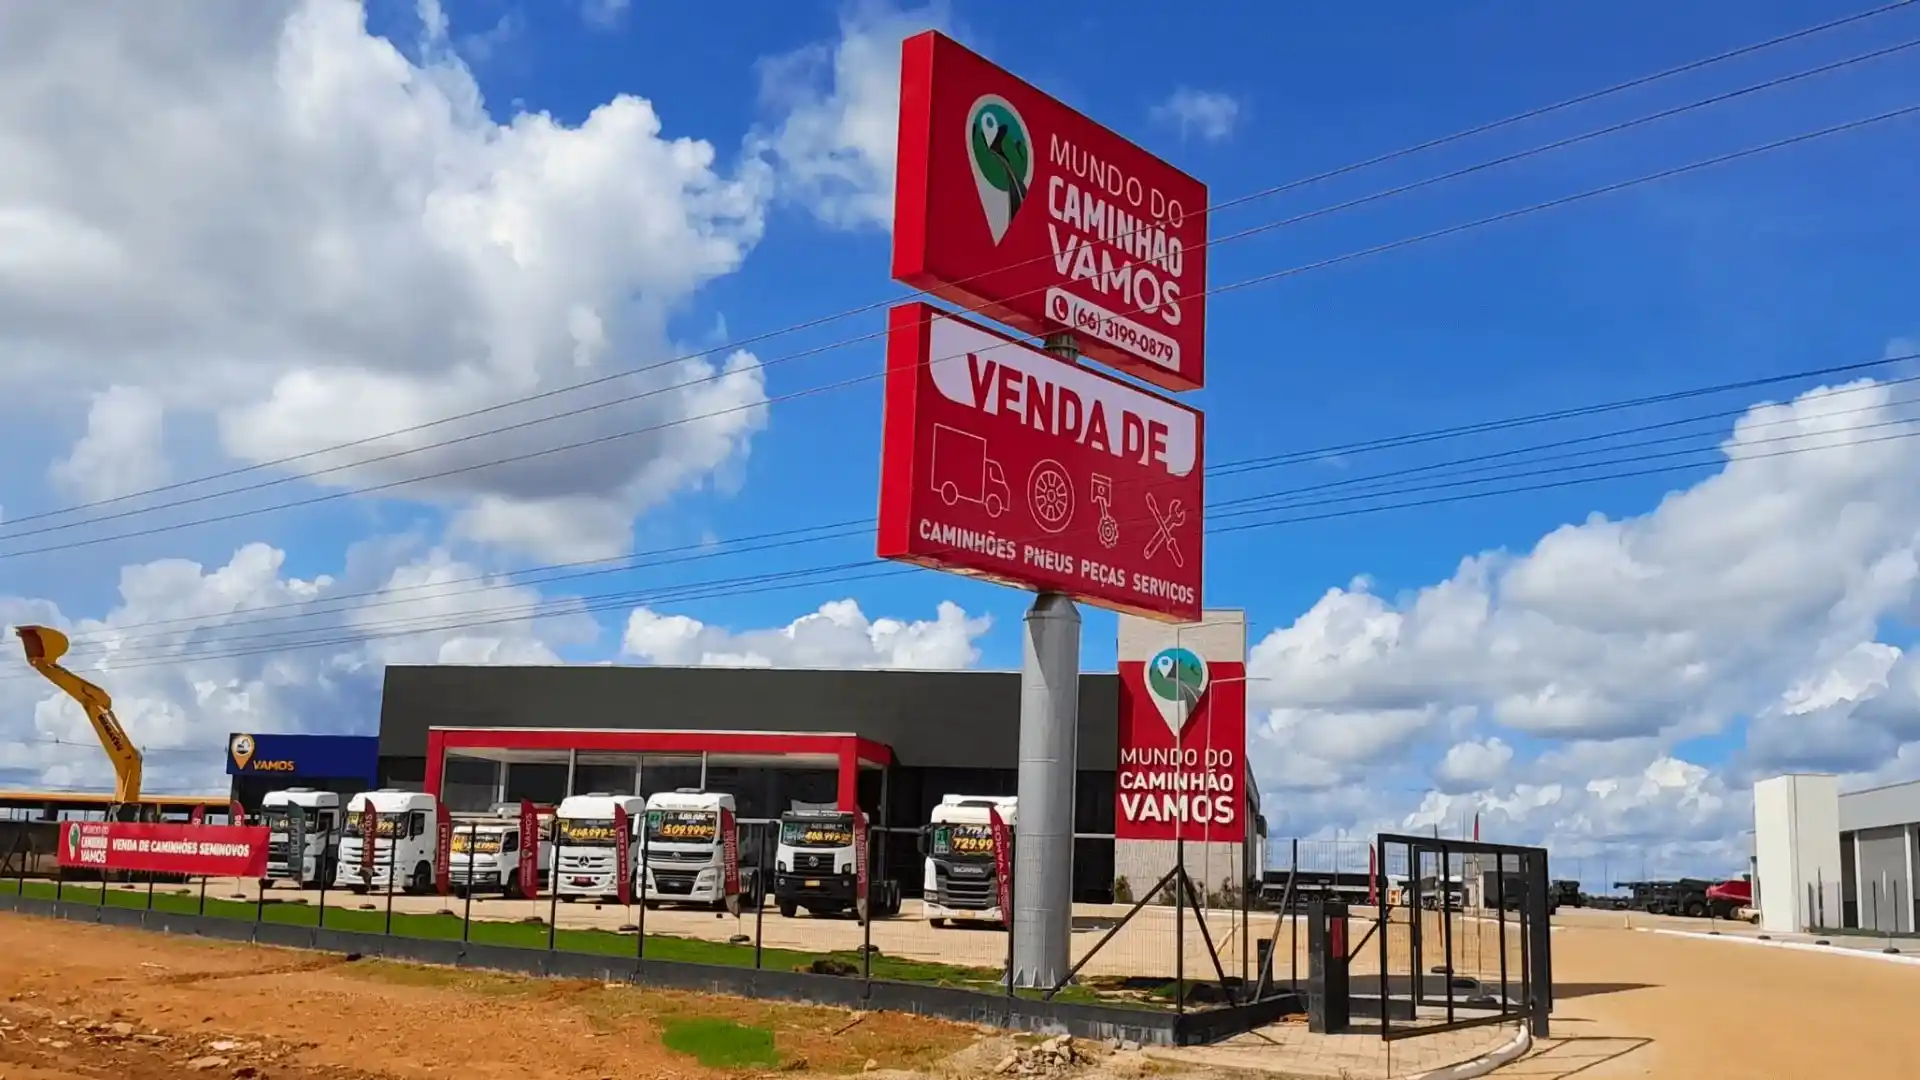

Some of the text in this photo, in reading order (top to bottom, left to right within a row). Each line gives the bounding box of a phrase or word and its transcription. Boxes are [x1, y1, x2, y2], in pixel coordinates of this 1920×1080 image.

[1049, 133, 1183, 229] MUNDO DO
[1049, 176, 1182, 278] CAMINHÃO
[1048, 223, 1181, 326] VAMOS
[1073, 302, 1174, 362] (66) 3199-0879
[967, 353, 1168, 470] VENDA DE
[920, 518, 1195, 605] CAMINHÕES PNEUS PEÇAS SERVIÇOS
[253, 760, 295, 771] VAMOS
[1121, 747, 1233, 767] MUNDO DO
[1119, 768, 1233, 792] CAMINHÃO
[1119, 794, 1234, 824] VAMOS
[112, 838, 137, 851] VENDA
[139, 840, 150, 852] DE
[199, 842, 249, 857] SEMINOVOS
[523, 812, 532, 848] VAMOS
[994, 823, 1005, 870] VAMOS
[81, 849, 106, 863] VAMOS
